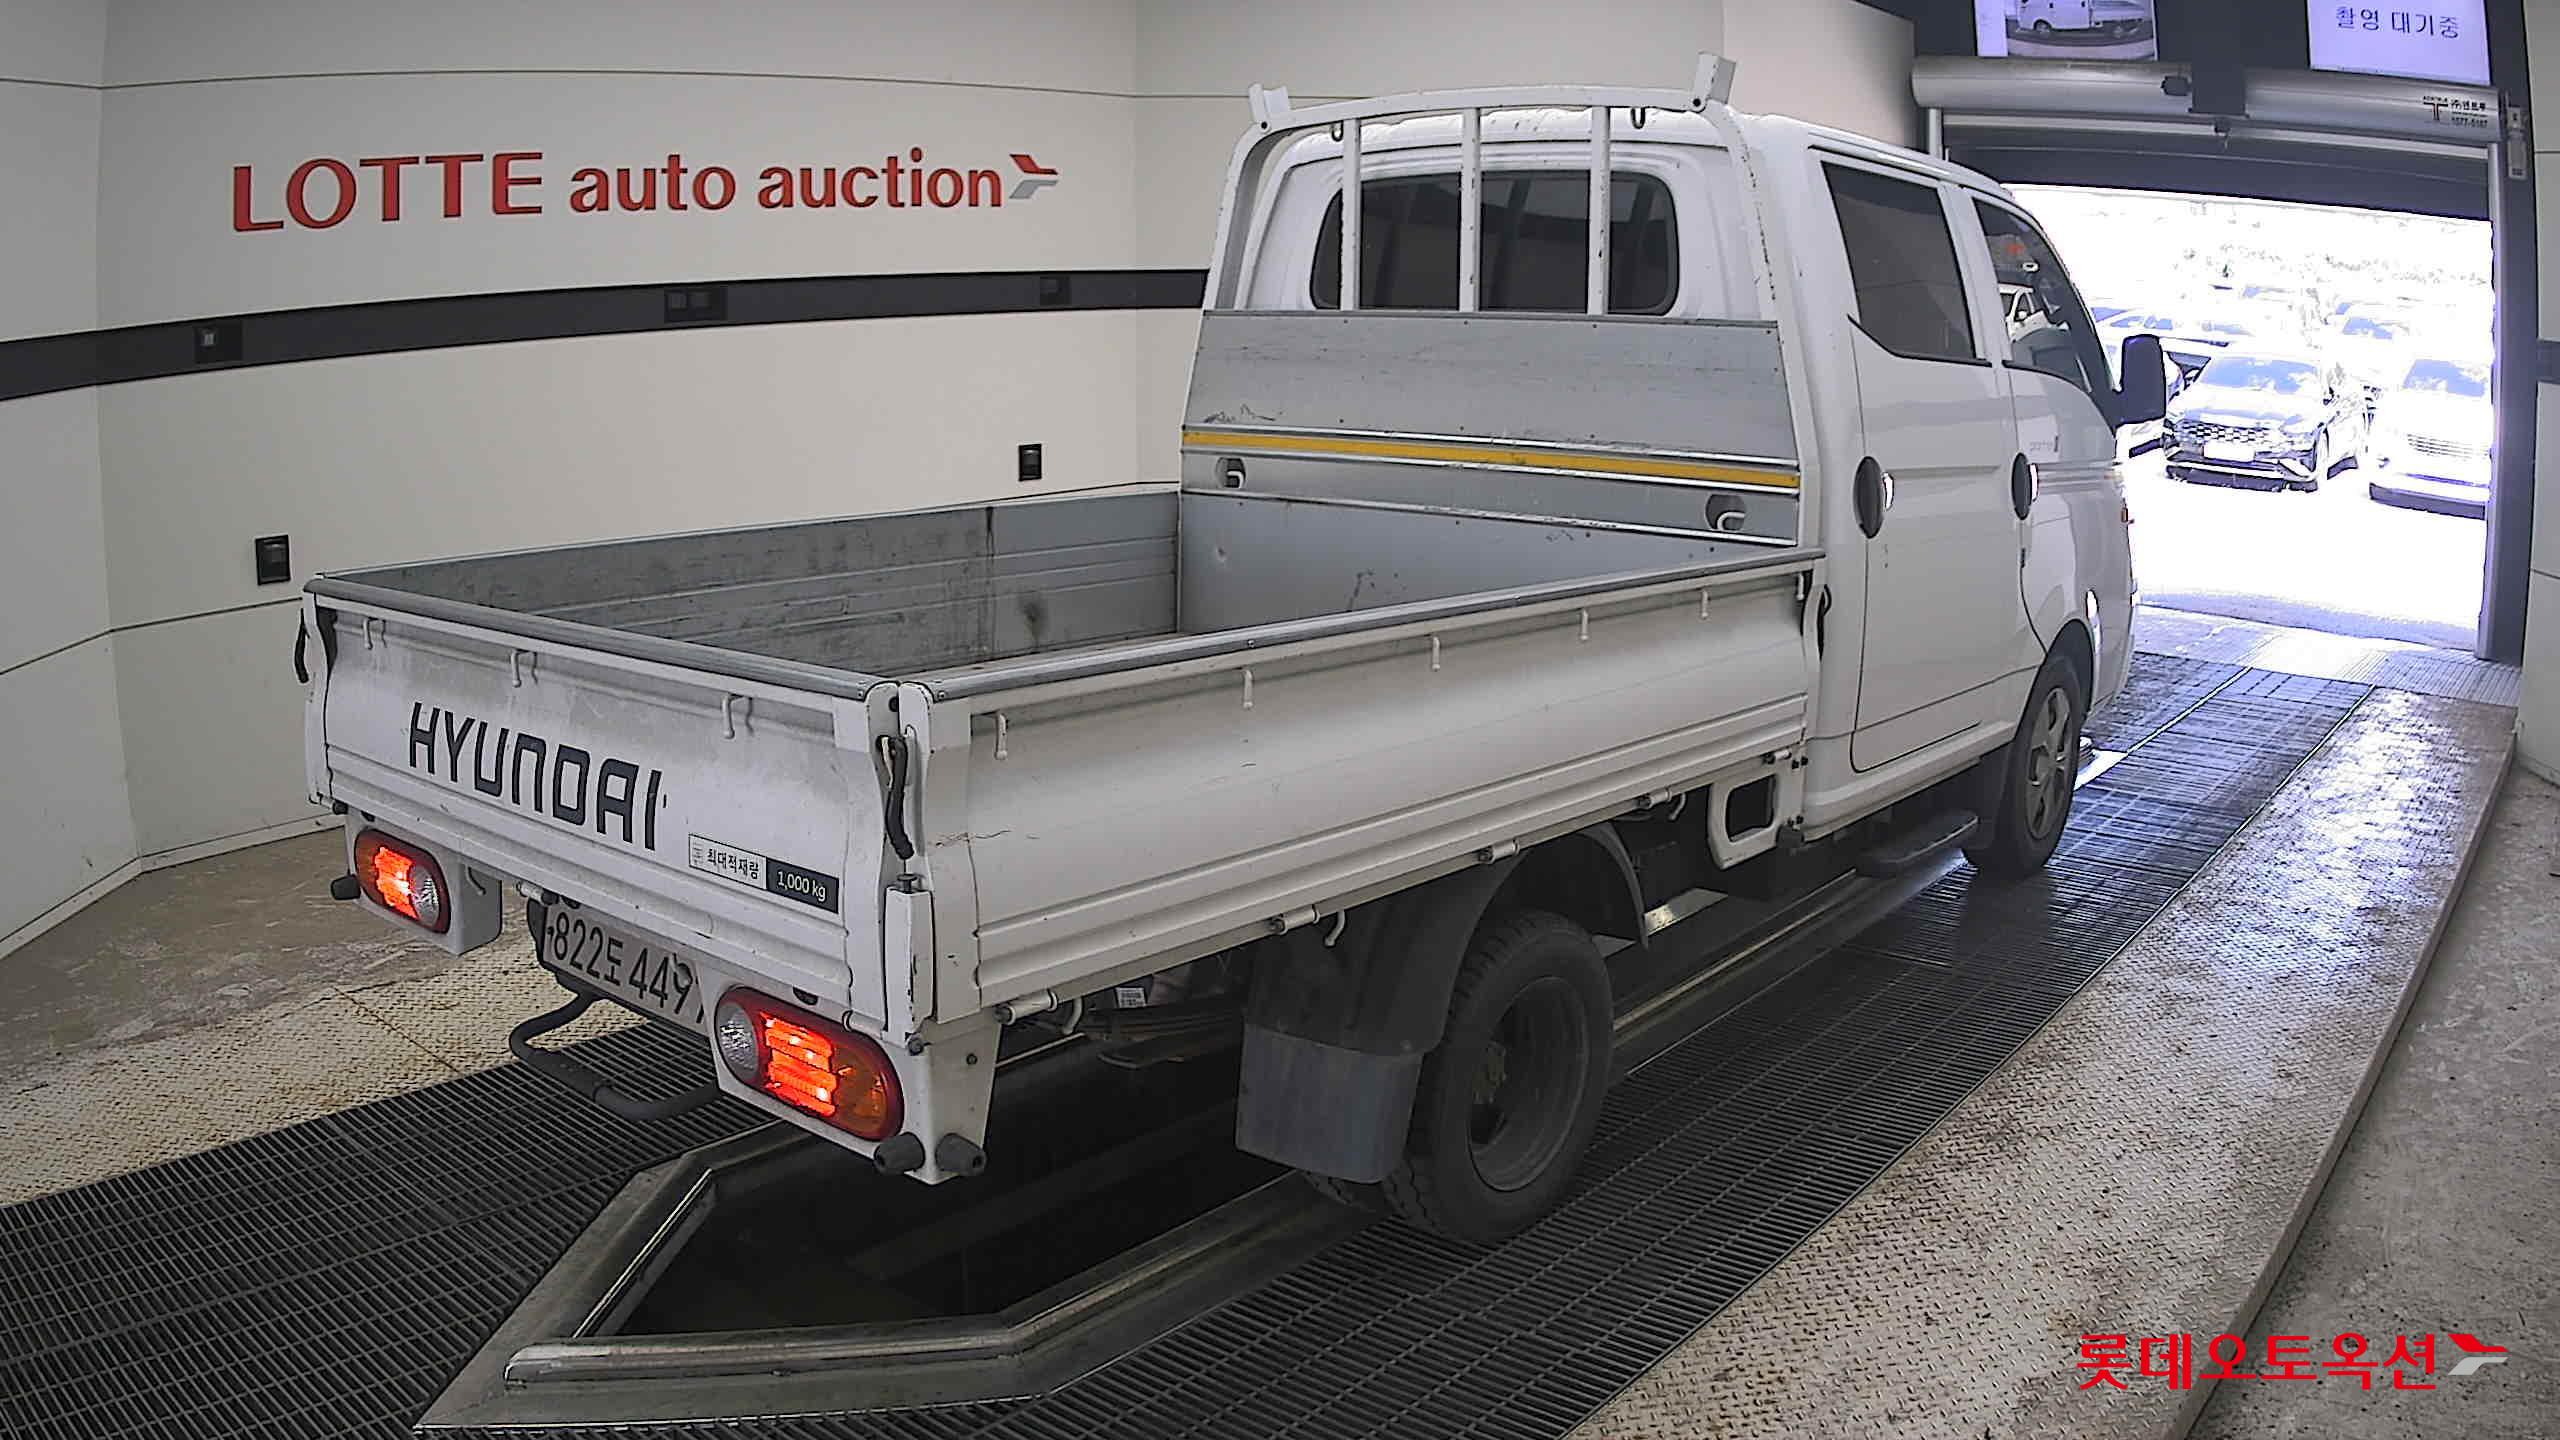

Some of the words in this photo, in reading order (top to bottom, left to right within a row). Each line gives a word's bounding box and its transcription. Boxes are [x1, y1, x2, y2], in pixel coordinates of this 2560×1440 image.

[2336, 6, 2380, 31] 촬영
[2391, 11, 2459, 38] 대기중
[233, 151, 543, 232] LOTTE
[569, 154, 736, 213] auto
[757, 147, 1003, 208] auction
[409, 702, 662, 851] HYUNDAI
[707, 848, 759, 880] 최대적재량
[777, 870, 810, 893] 1,000
[812, 879, 826, 901] kg
